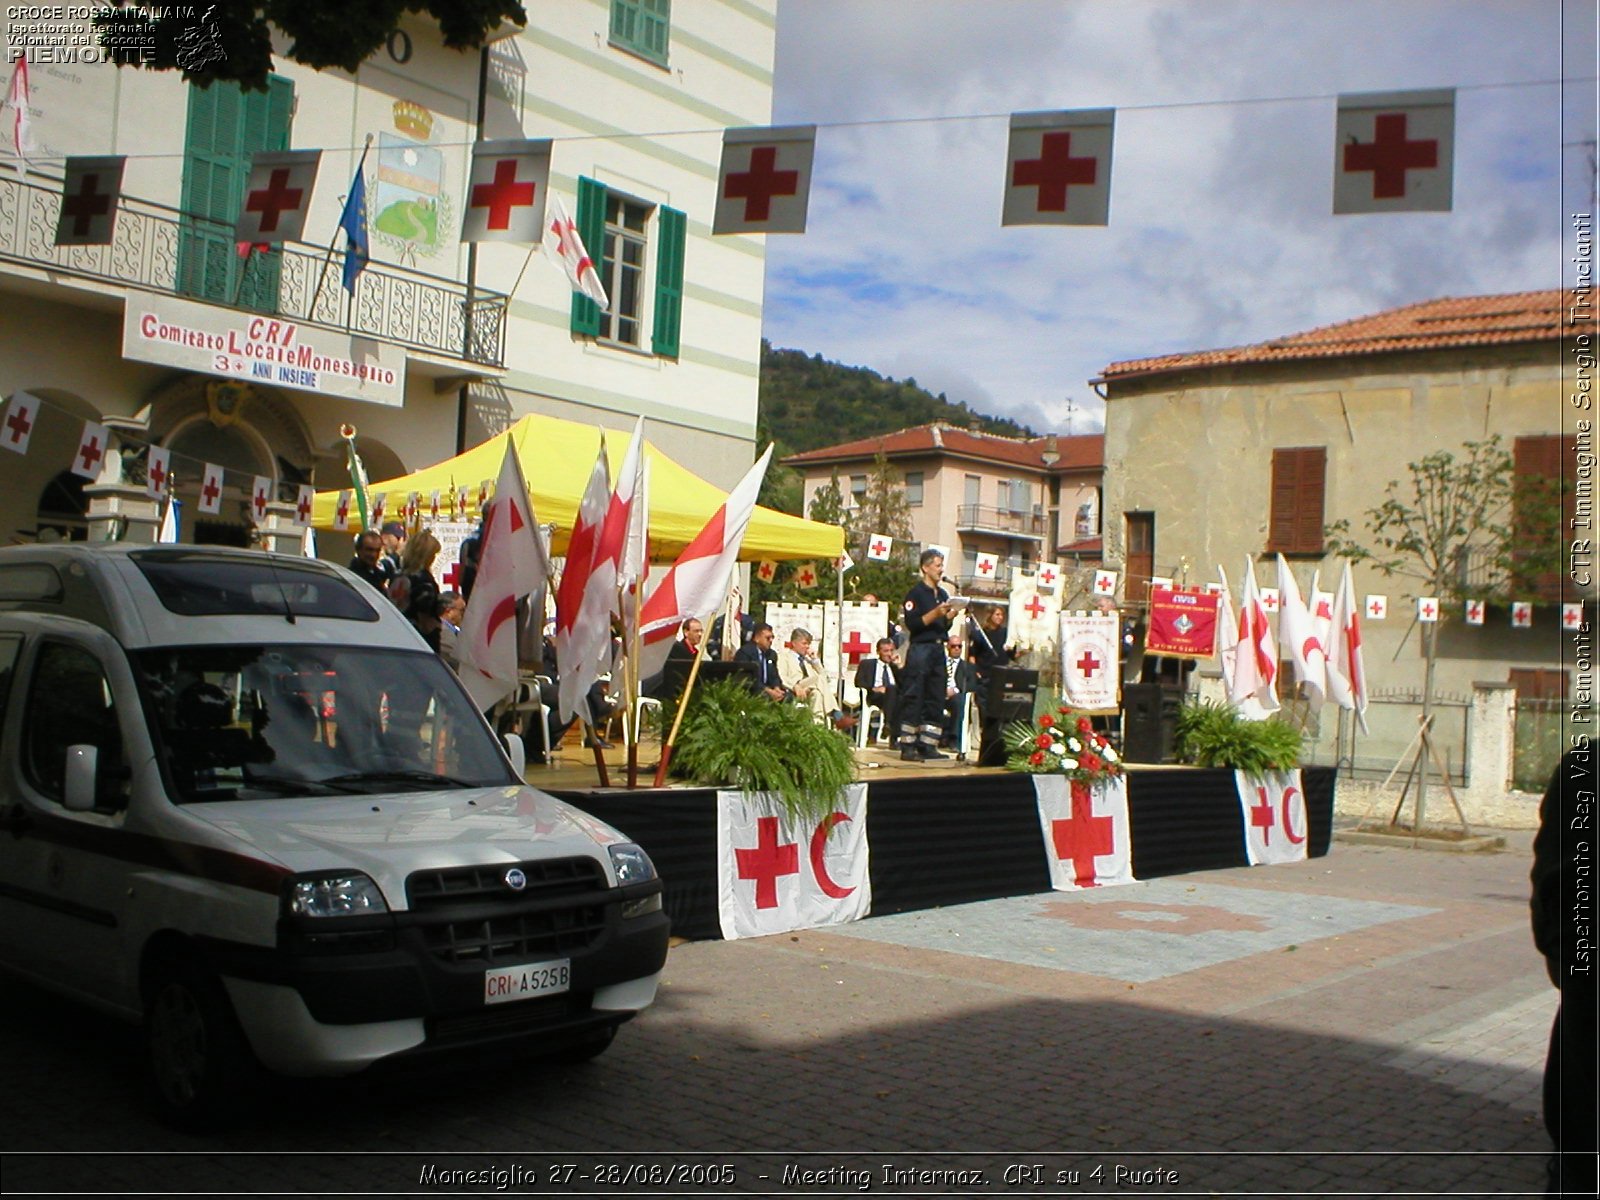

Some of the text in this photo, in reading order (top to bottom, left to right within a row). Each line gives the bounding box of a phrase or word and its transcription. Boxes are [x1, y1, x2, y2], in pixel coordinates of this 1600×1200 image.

[141, 314, 224, 351] Comitato
[249, 318, 297, 347] CRI
[252, 361, 273, 380] ANNI
[278, 366, 317, 389] INSIEME
[487, 966, 569, 997] CRI A525B
